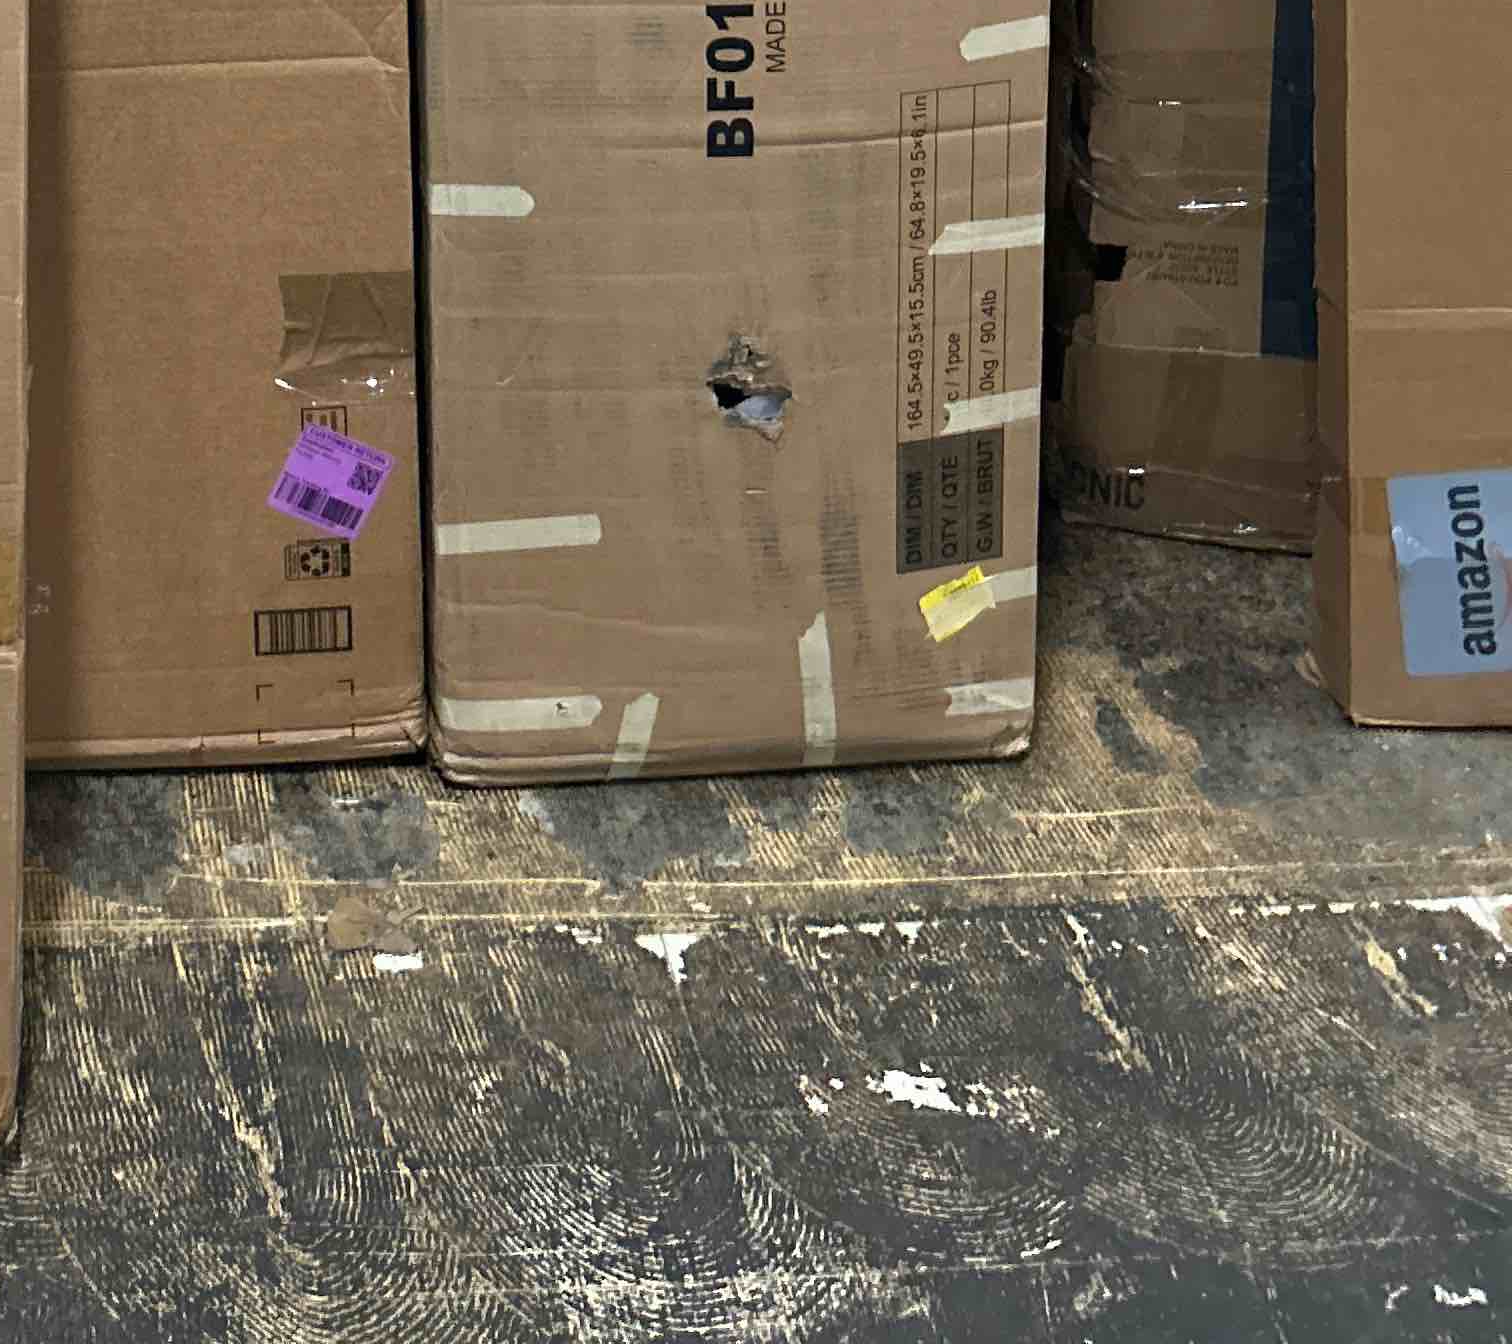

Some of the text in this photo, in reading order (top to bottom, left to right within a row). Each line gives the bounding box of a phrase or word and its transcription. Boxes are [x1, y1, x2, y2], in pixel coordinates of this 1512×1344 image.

[765, 1, 786, 73] MADE
[979, 289, 997, 343] 90.4lb
[945, 331, 962, 374] 1pce
[906, 471, 924, 508] DIM
[977, 439, 994, 496] BRUT
[906, 527, 923, 564] DIM
[942, 519, 959, 558] QTY
[1447, 484, 1497, 657] amazon
